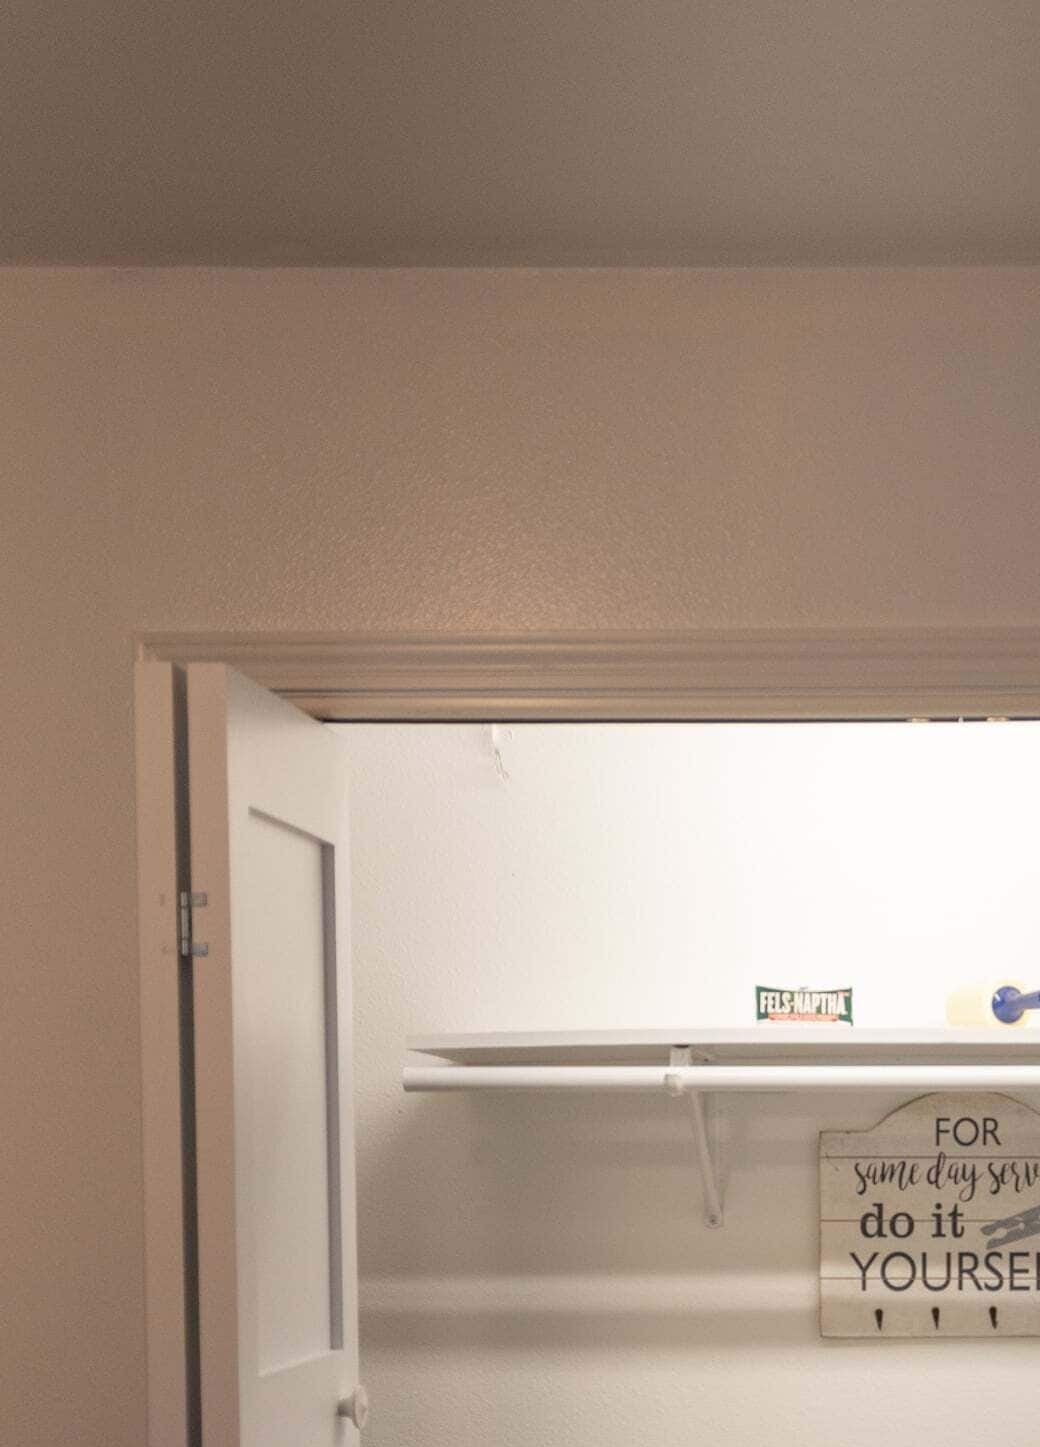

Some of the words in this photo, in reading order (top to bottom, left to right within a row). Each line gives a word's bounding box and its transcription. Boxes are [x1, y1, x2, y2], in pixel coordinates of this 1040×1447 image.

[935, 1117, 1002, 1146] FOR
[854, 1160, 922, 1195] same
[927, 1152, 984, 1202] day
[860, 1203, 914, 1238] do
[931, 1203, 965, 1238] it
